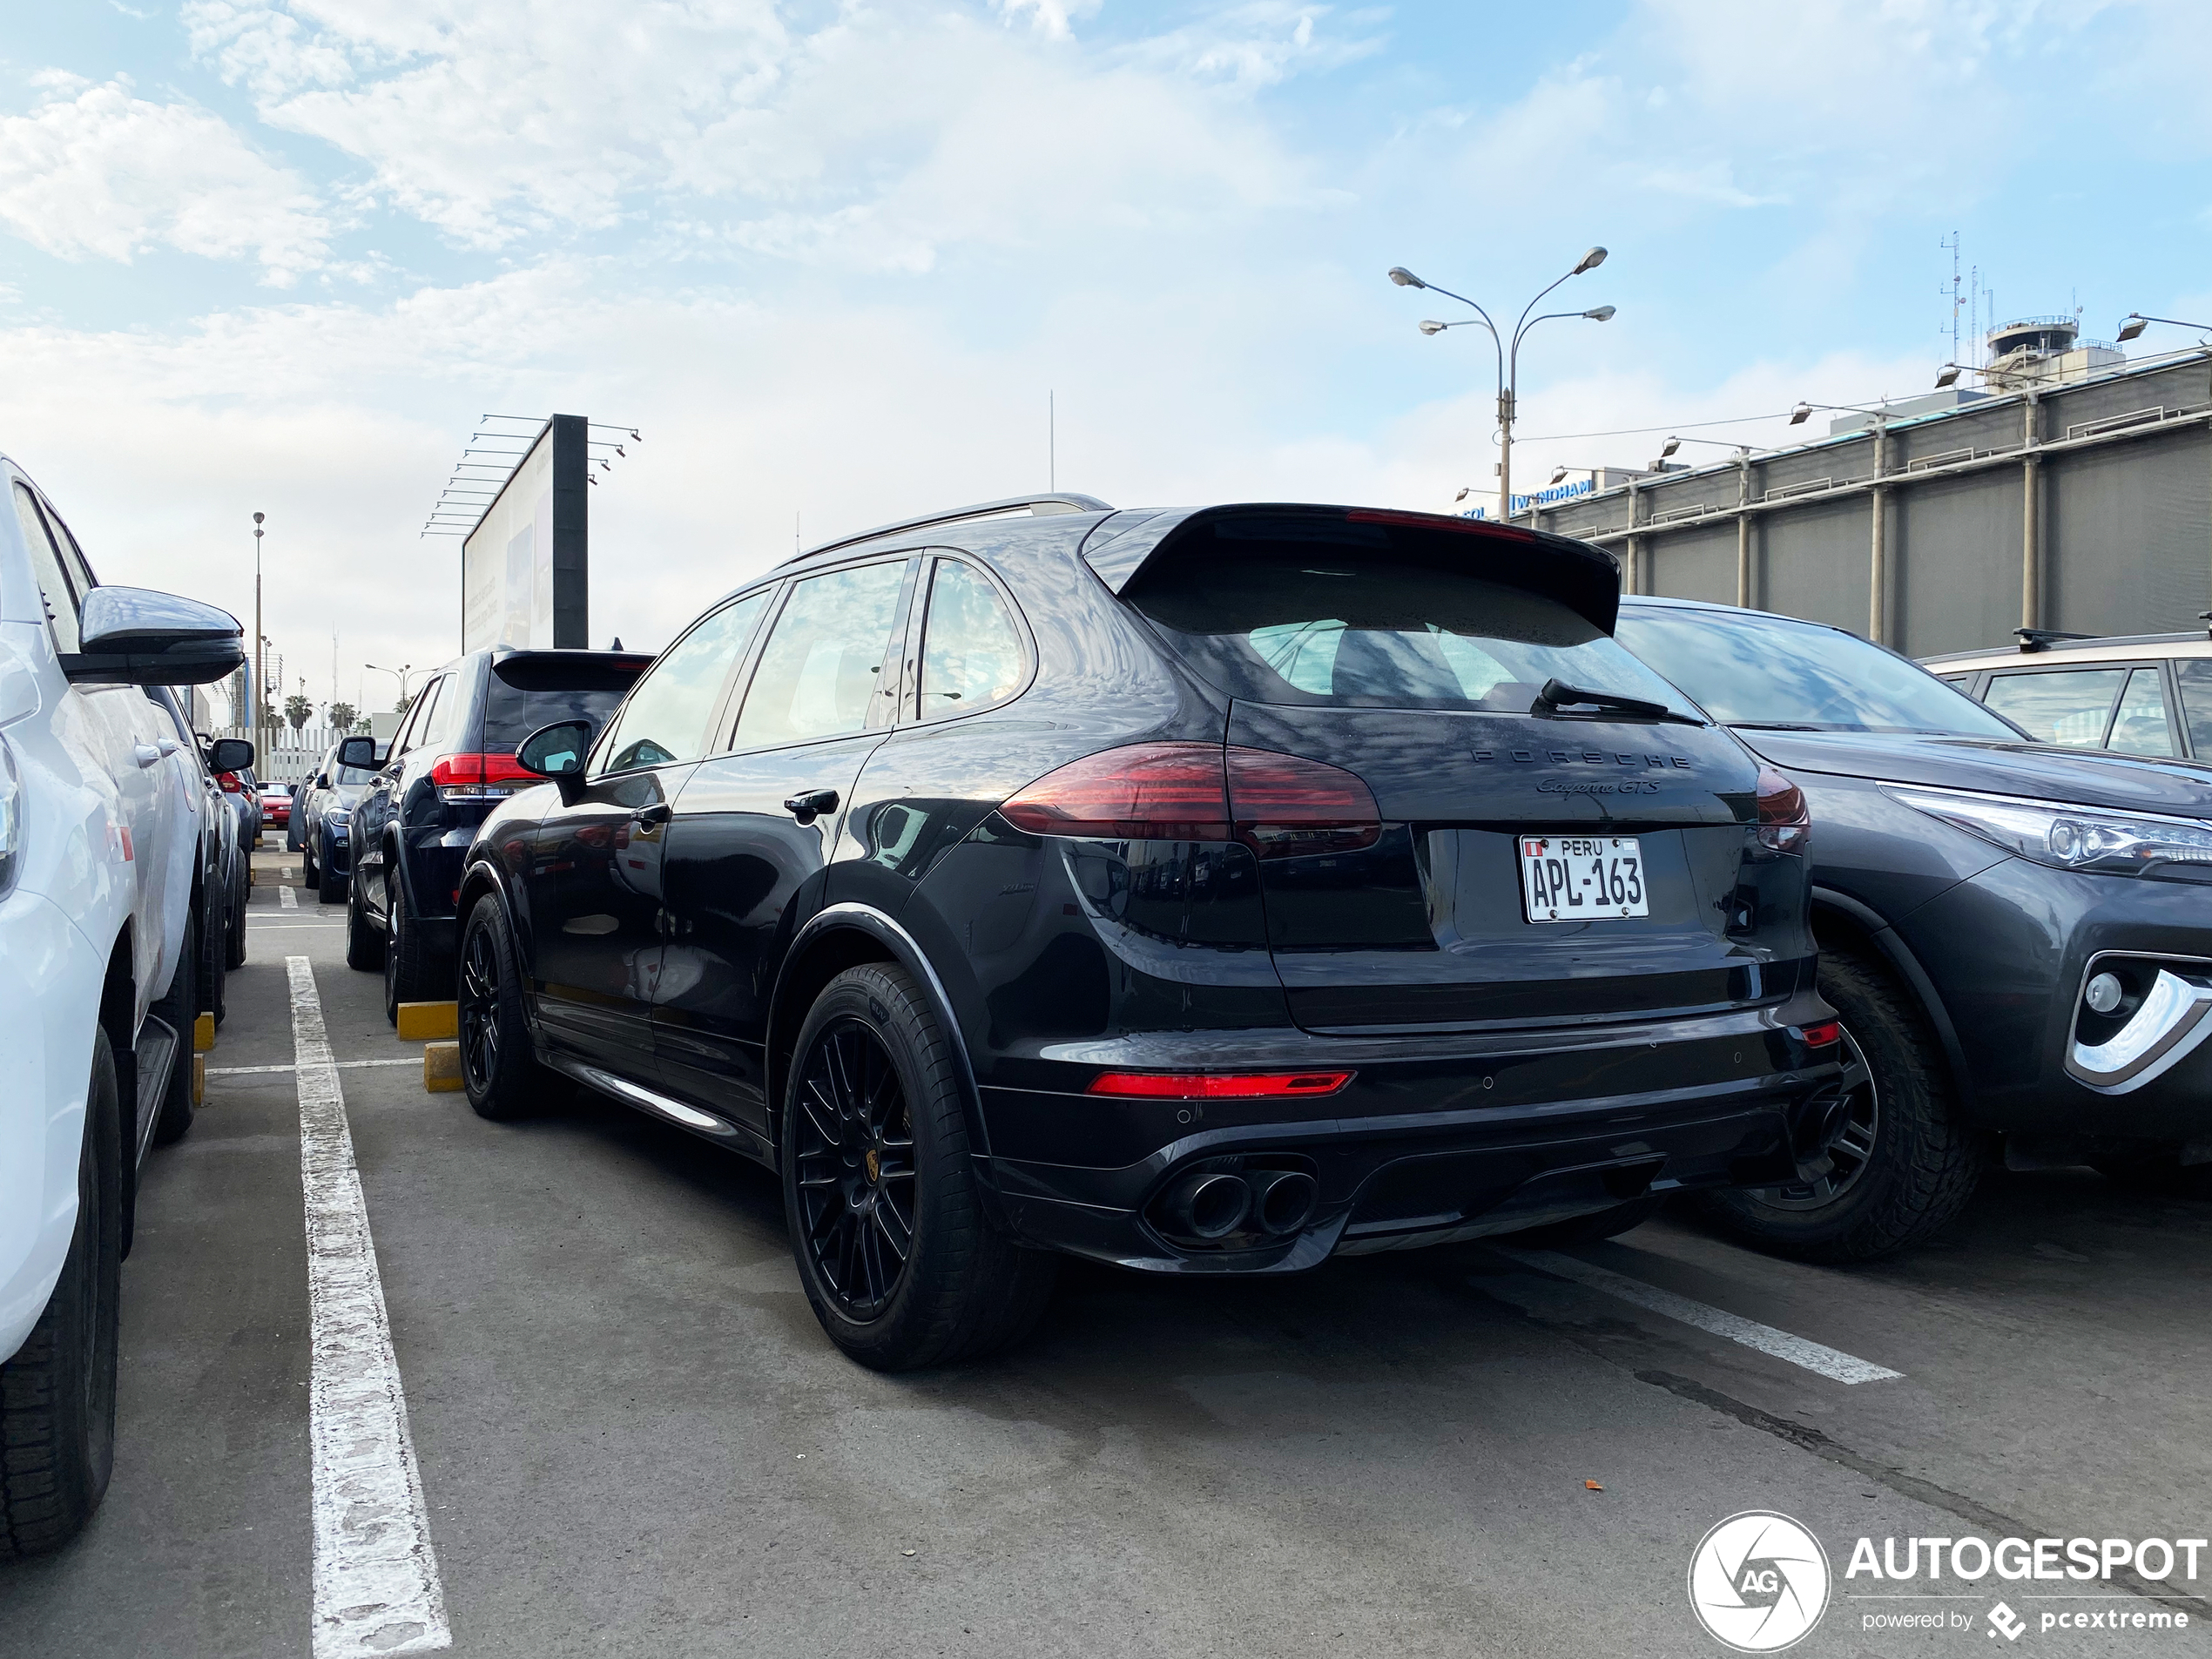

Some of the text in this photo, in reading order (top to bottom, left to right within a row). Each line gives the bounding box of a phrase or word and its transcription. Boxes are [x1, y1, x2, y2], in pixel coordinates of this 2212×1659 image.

[1470, 749, 1691, 769] PORSCHE
[1535, 779, 1662, 801] Cayenne GTS
[1562, 840, 1603, 856] PERU
[1534, 858, 1642, 907] APL-163
